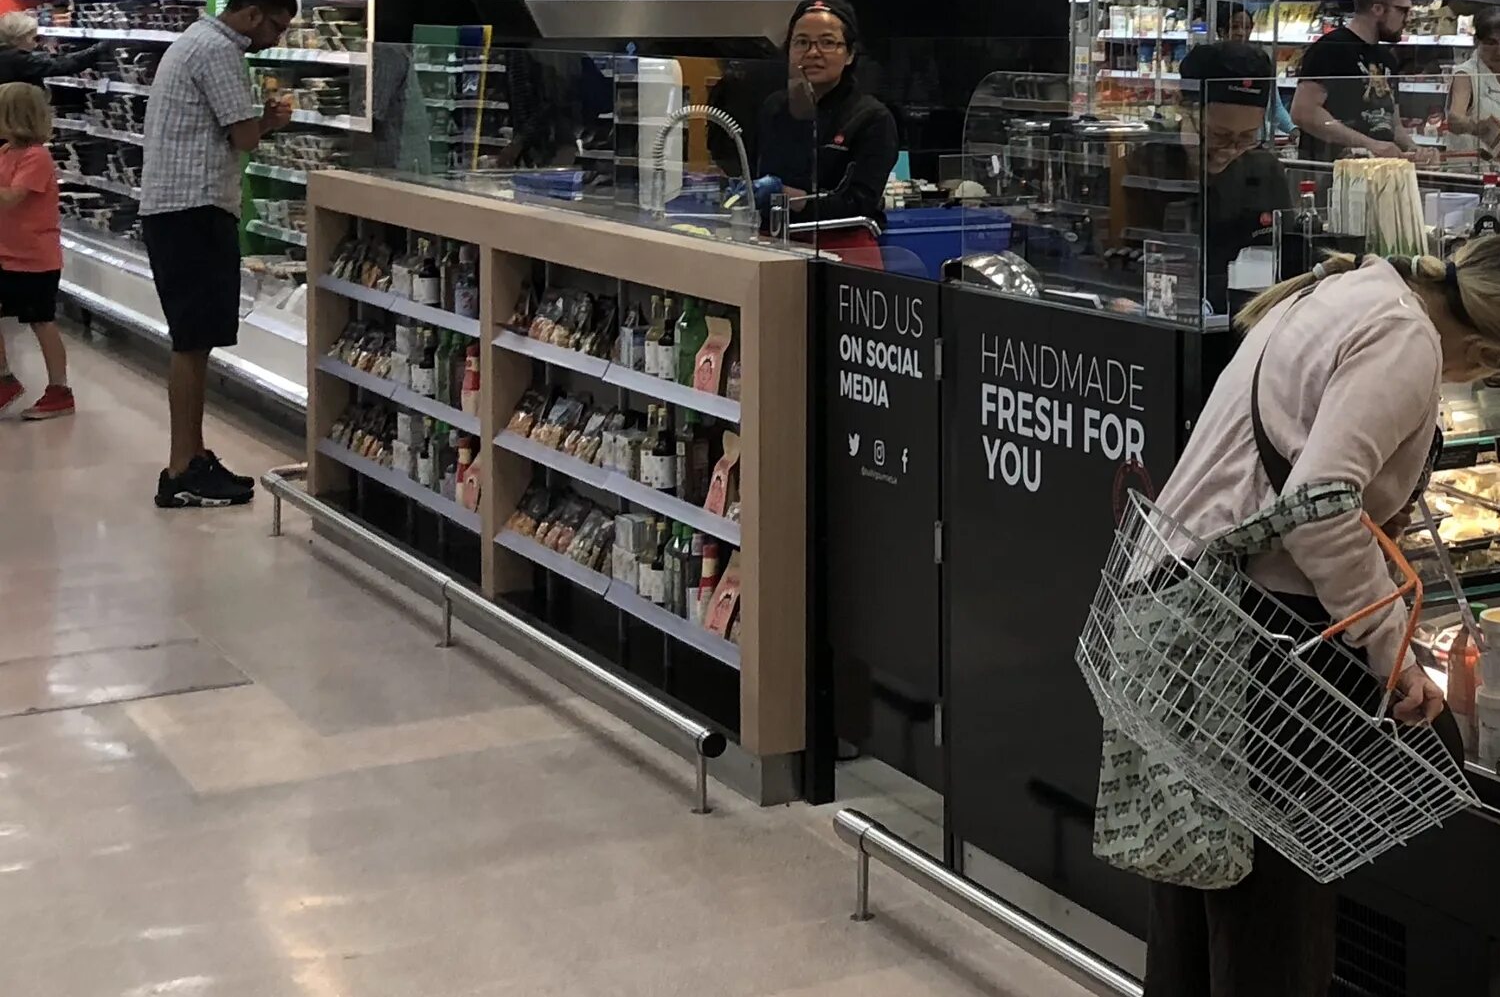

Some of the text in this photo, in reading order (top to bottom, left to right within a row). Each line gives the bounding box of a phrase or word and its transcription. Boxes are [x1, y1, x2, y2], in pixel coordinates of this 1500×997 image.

[838, 283, 924, 339] FIND US
[838, 333, 923, 379] ON SOCIAL
[981, 332, 1145, 412] HANDMADE
[839, 369, 890, 409] MEDIA
[981, 382, 1145, 468] FRESH FOR
[982, 434, 1042, 493] YOU
